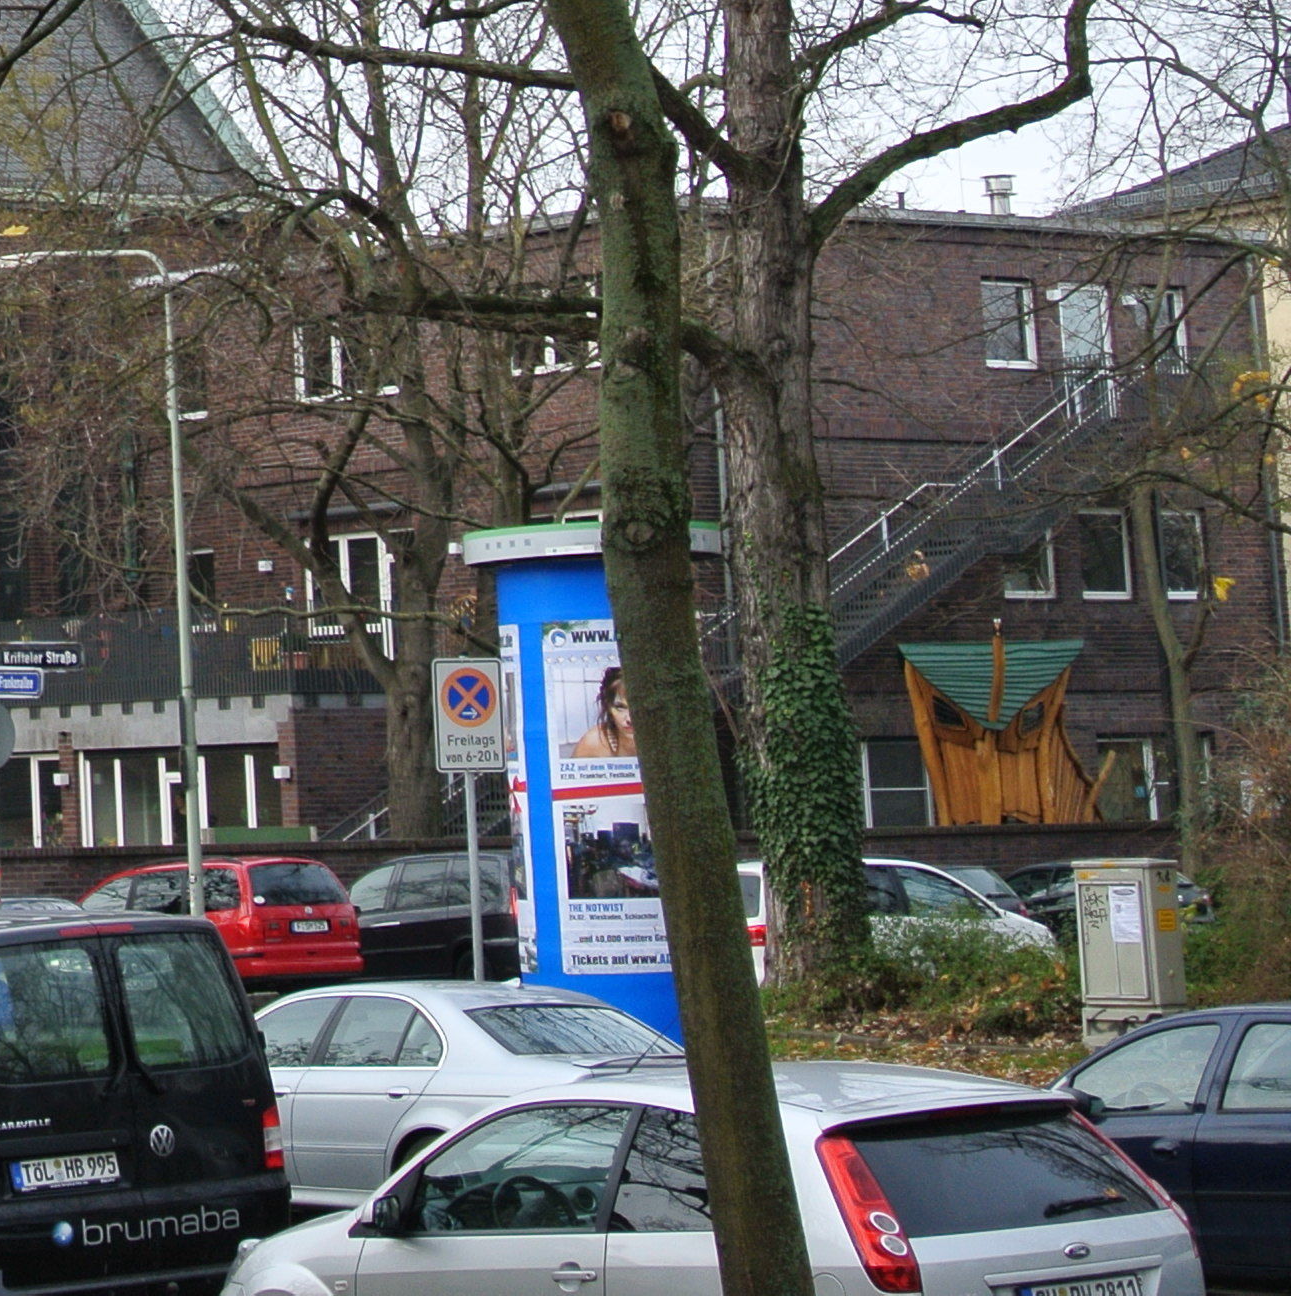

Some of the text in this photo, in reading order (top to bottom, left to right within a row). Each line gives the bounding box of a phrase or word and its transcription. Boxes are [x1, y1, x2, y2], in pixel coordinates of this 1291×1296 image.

[3, 650, 77, 664] Krifteler Straße
[447, 734, 495, 748] Freitags
[445, 750, 499, 762] von 6-20 h
[560, 764, 575, 772] ZAZ
[569, 903, 624, 912] THE NOTWIST
[571, 954, 609, 965] Tickets
[611, 954, 629, 965] auf
[64, 1158, 86, 1179] HB
[88, 1155, 117, 1176] 995
[82, 1205, 240, 1246] brumaba
